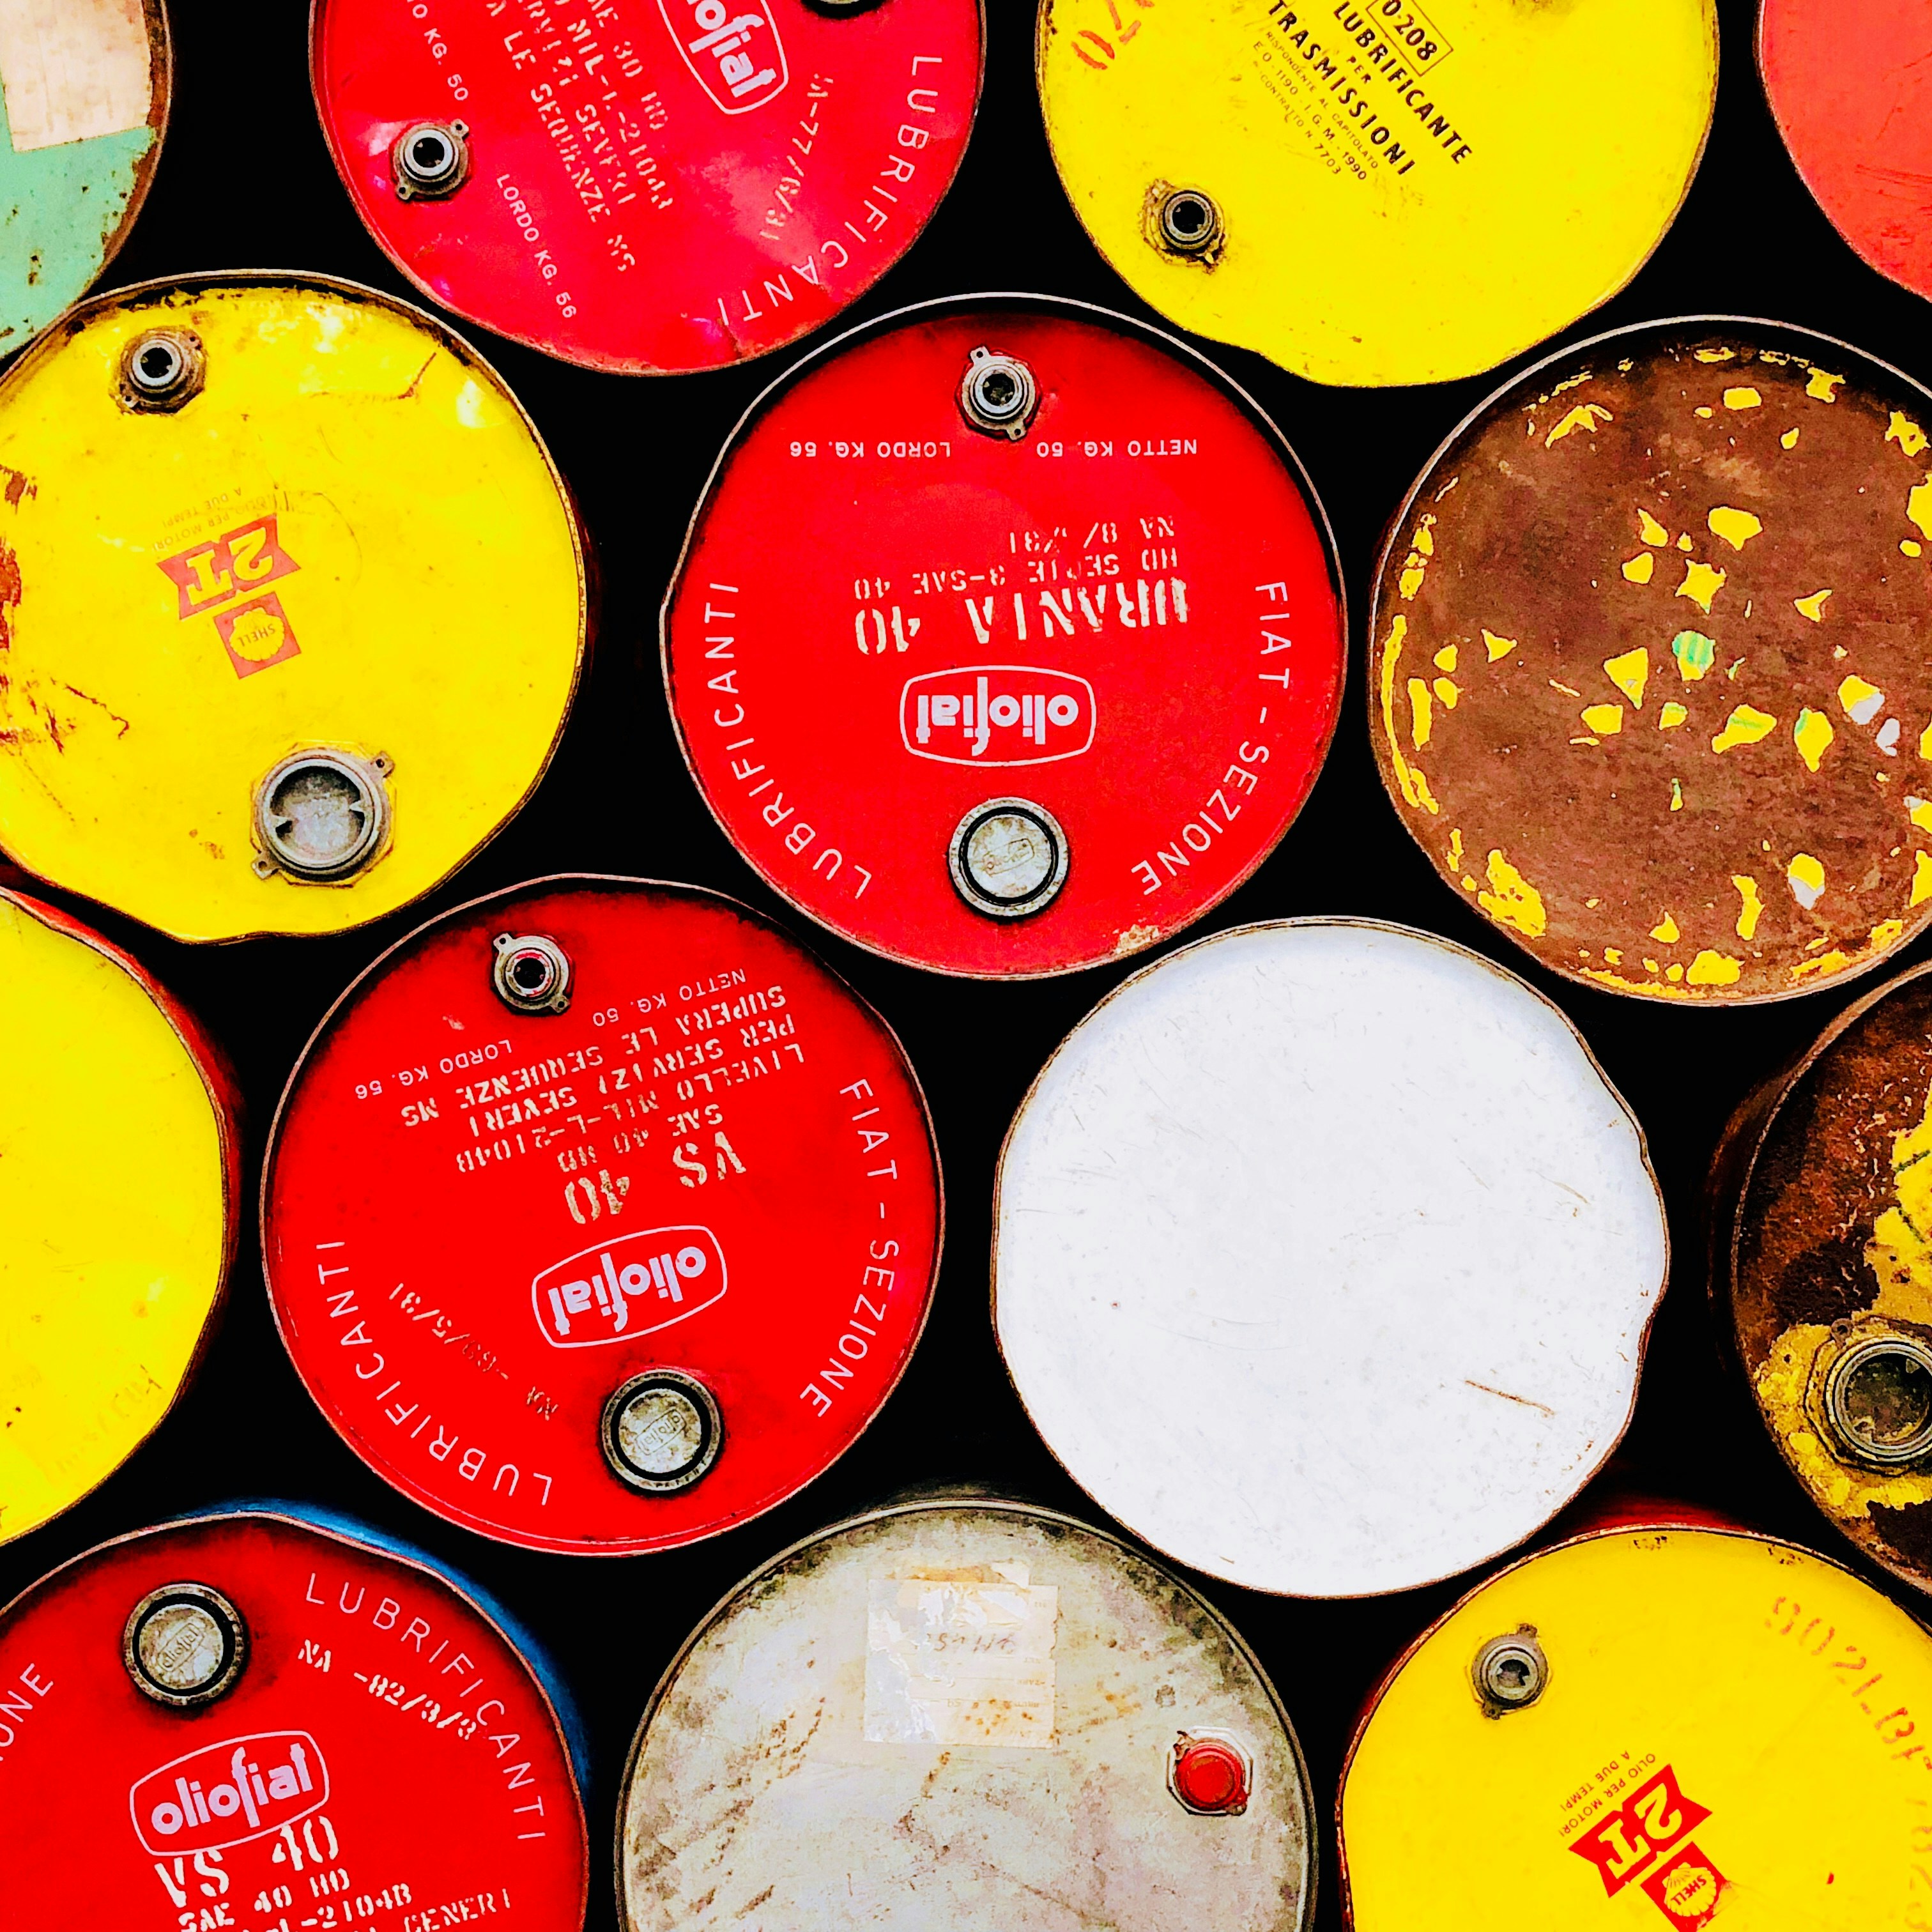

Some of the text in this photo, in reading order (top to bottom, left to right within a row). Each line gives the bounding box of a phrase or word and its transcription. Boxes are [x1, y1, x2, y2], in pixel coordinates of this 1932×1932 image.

[407, 0, 468, 100] O KG. 50
[504, 31, 535, 70] LE
[518, 0, 578, 85] RVIZI
[614, 42, 642, 77] 30
[687, 0, 776, 98] ofiat
[1346, 55, 1371, 84] PER
[1268, 0, 1415, 175] TRASMISSIONI
[1318, 98, 1330, 112] AL
[1333, 0, 1473, 164] LUBRIFICANTE
[1314, 142, 1342, 175] 7703
[1342, 150, 1368, 181] 1990
[718, 57, 942, 325] LUBRIFICANTI
[497, 174, 576, 317] LORDO KG. 56
[790, 441, 950, 457] LORDO KG. 56
[1037, 440, 1197, 457] NETTO KG. 50
[185, 527, 273, 606] 2T
[855, 578, 890, 599] 40
[1142, 548, 1177, 571] HD
[237, 624, 275, 648] SHELL
[855, 576, 1188, 654] URANIA 40
[1255, 582, 1291, 689] FIAT
[704, 583, 873, 900] LUBRIFICANTI
[1131, 741, 1269, 895] SEZIONE
[593, 969, 746, 1026] NETTO KG. 50
[676, 986, 786, 1035] SUPERA
[355, 1040, 511, 1099] LORDO KG. 56
[622, 1027, 657, 1054] LE
[470, 1014, 795, 1137] PER SERVIZI SEVERI
[677, 1044, 804, 1100] LIVELLO
[401, 1098, 439, 1126] MS
[614, 1128, 648, 1153] 40
[668, 1104, 723, 1136] SAE
[840, 1079, 897, 1179] FIAT
[565, 1131, 746, 1224] VS 40
[800, 1240, 899, 1417] SEZIONE
[316, 1242, 552, 1505] LUBRIFICANTI
[298, 1639, 331, 1672] NA
[0, 1662, 54, 1761] ONE
[307, 1573, 545, 1839] LUBRIFICANTI
[1558, 1753, 1656, 1837] OLIO PER MOTORI
[1560, 1751, 1631, 1812] A DUE TEMPI
[1598, 1782, 1683, 1880] 2T
[155, 1816, 339, 1908] VS 40
[254, 1885, 292, 1912] 40
[310, 1868, 349, 1897] HD
[1671, 1874, 1707, 1906] SHELL
